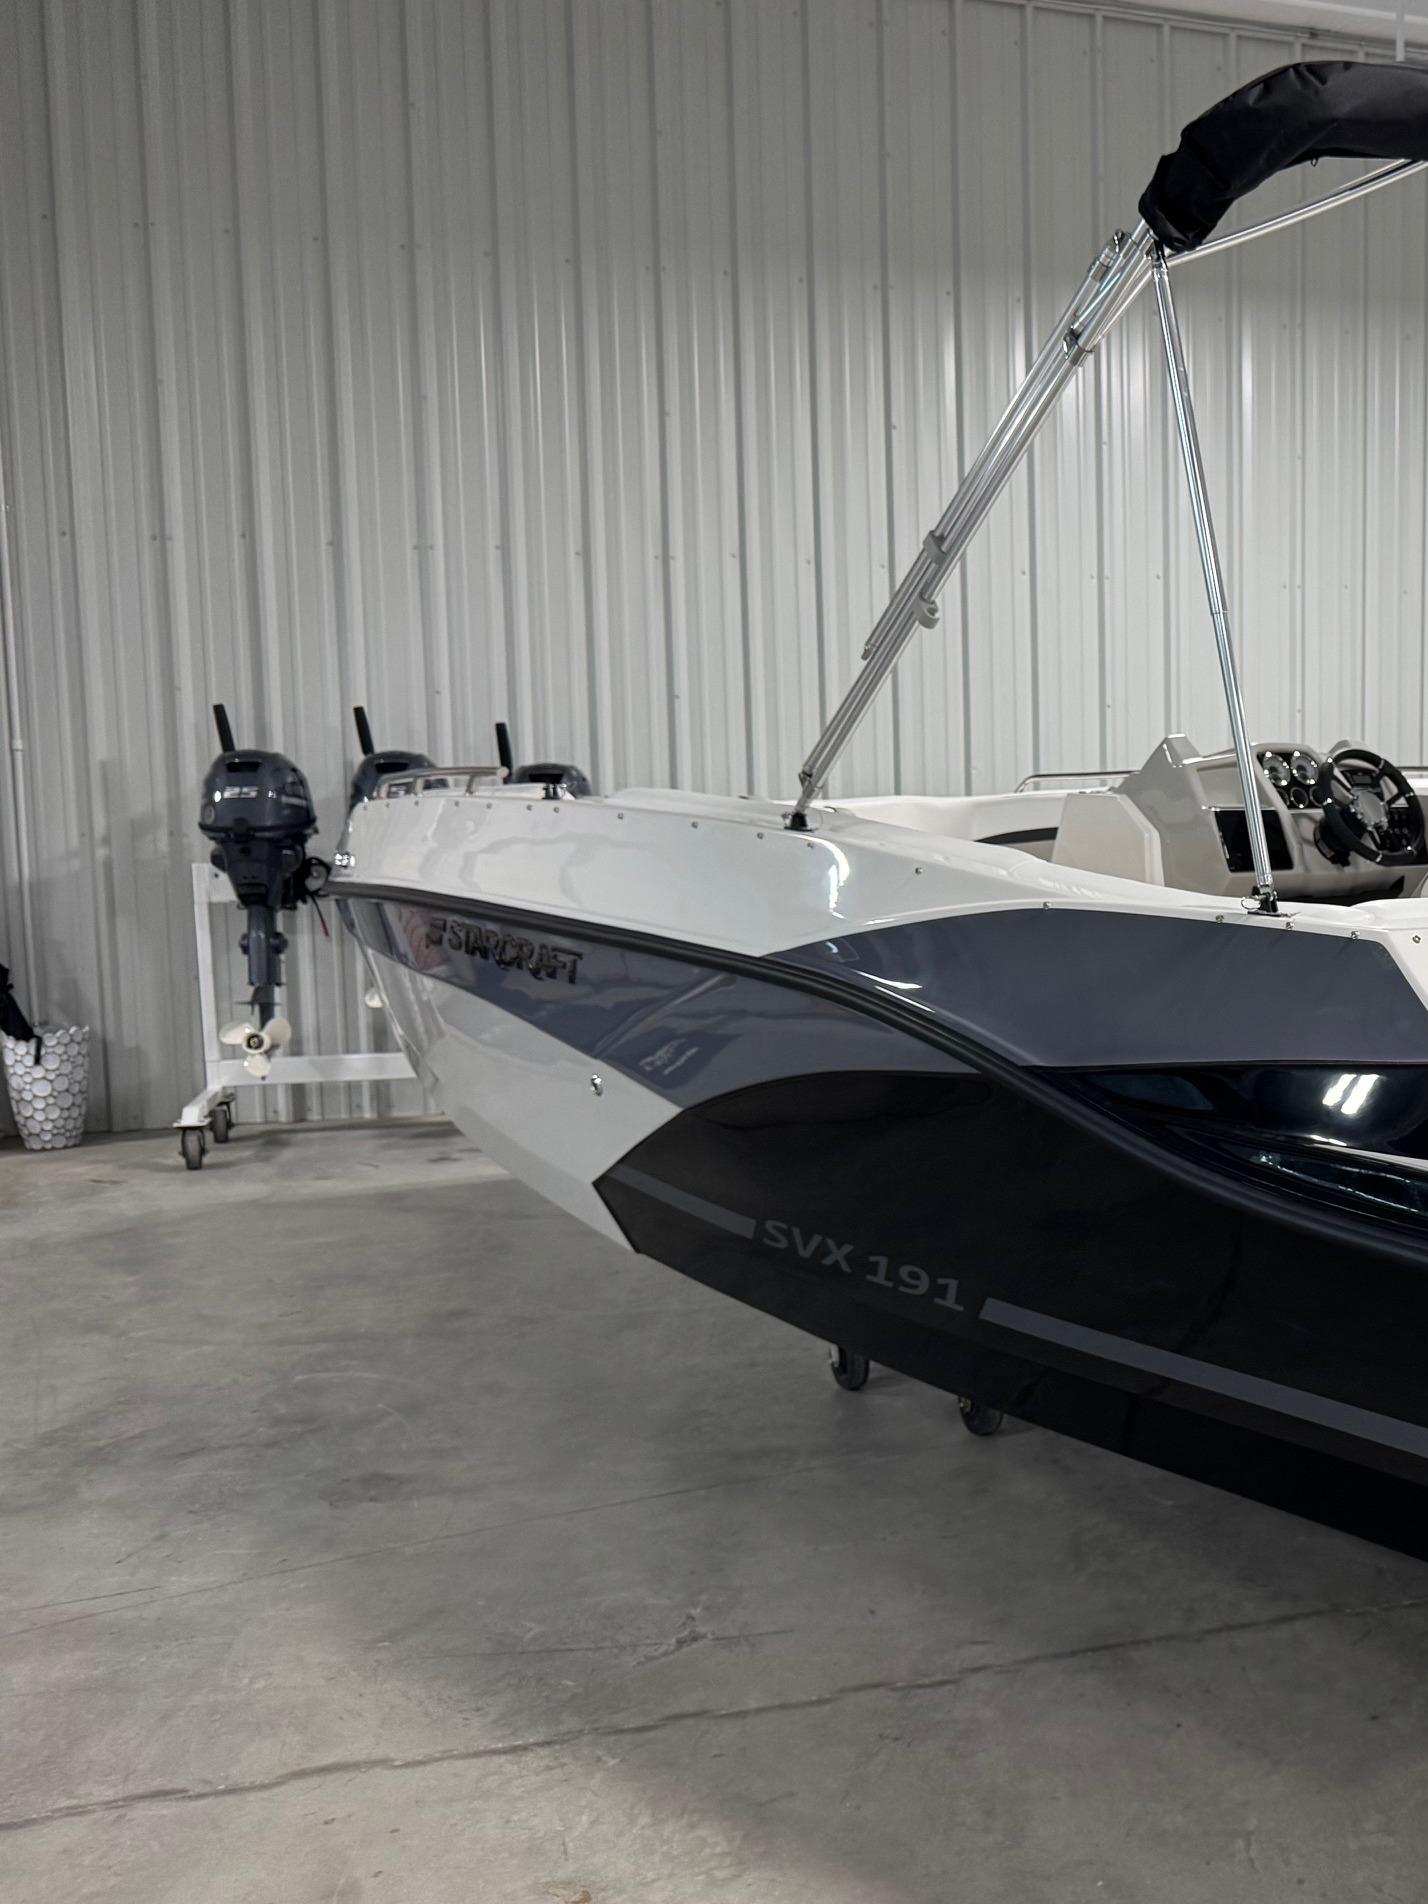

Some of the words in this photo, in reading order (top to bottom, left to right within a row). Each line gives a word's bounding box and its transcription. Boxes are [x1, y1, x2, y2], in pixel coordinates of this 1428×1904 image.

[223, 786, 259, 799] 25
[448, 920, 583, 985] STARCRAFT
[762, 1219, 854, 1273] SVX
[865, 1255, 965, 1312] 191
